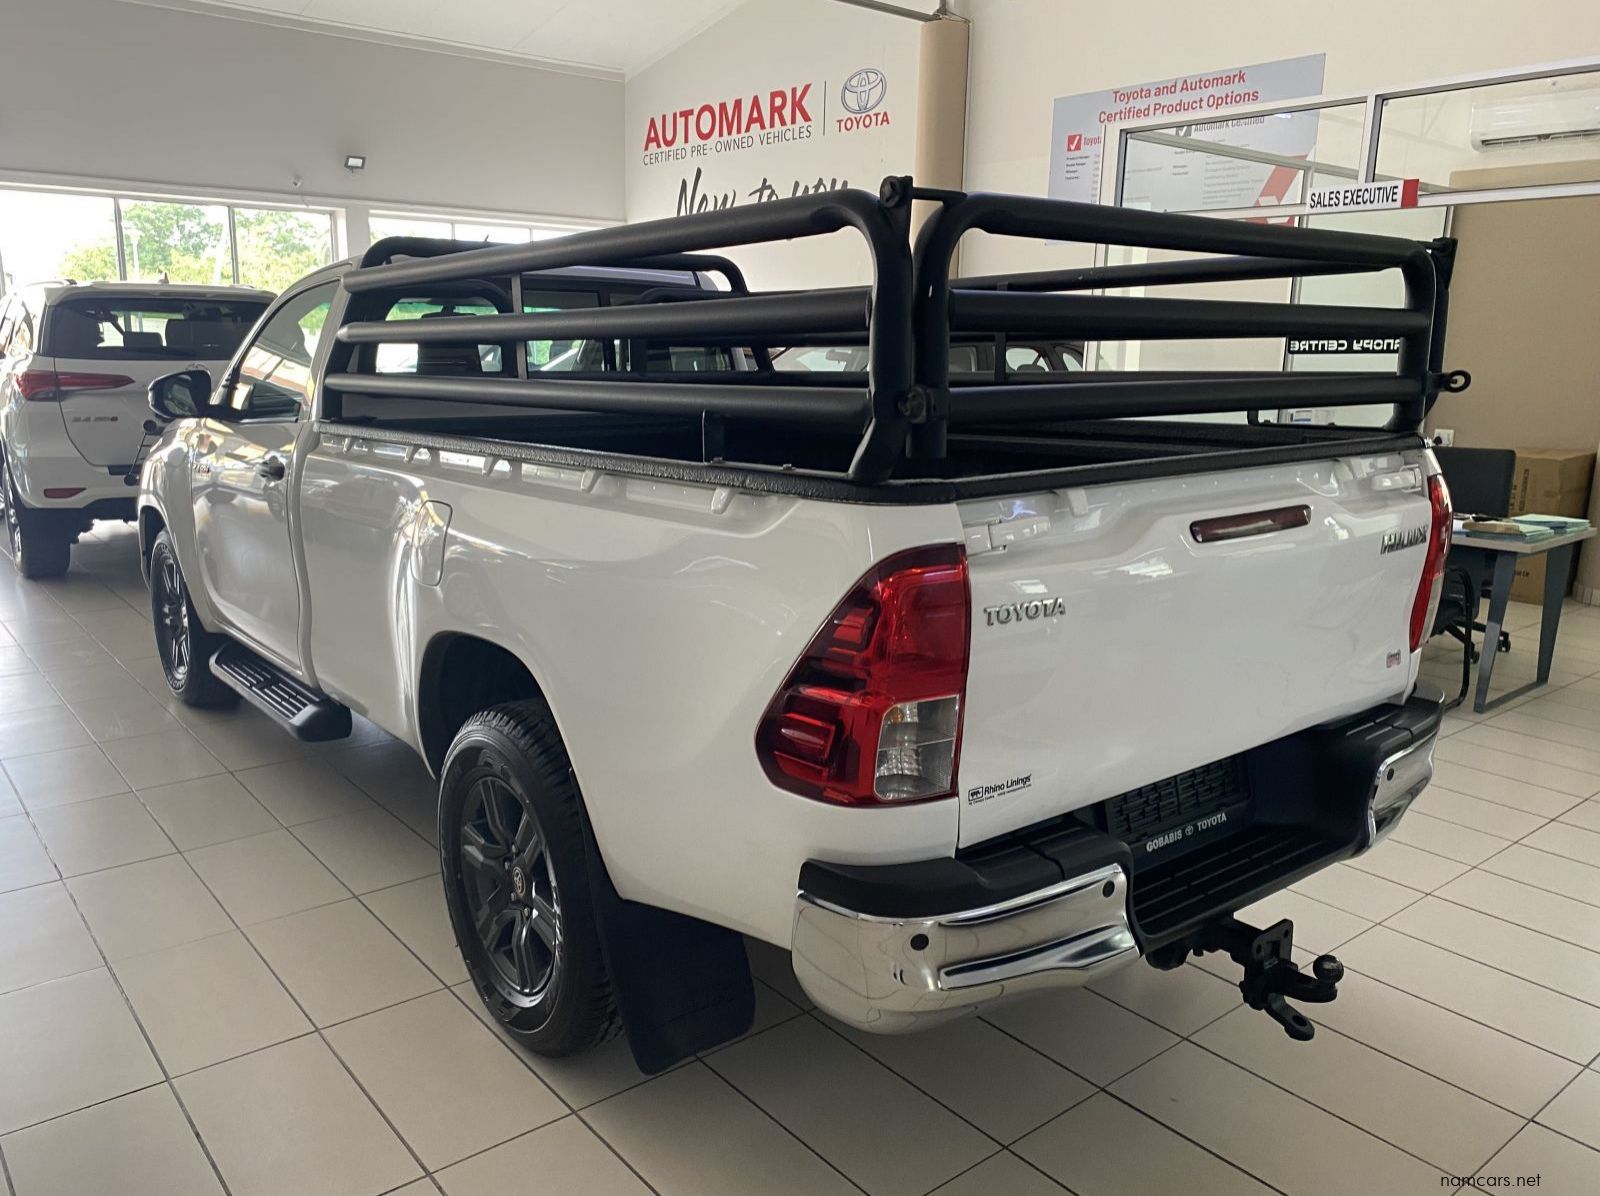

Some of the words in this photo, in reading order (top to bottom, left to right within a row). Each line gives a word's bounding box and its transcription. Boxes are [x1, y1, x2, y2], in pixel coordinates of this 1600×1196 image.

[1112, 87, 1150, 104] Toyota
[1154, 80, 1176, 96] and
[1179, 70, 1245, 92] Automark
[644, 83, 812, 151] AUTOMARK
[836, 111, 890, 132] TOYOTA
[1098, 105, 1149, 123] Certified
[1152, 99, 1202, 115] Product
[1206, 90, 1259, 109] Options
[643, 147, 686, 165] CERTIFIED
[758, 125, 812, 145] VEHICLES
[1309, 190, 1340, 208] SALES
[1342, 185, 1398, 206] EXECUTIVE
[1380, 526, 1426, 554] HILUX
[983, 597, 1065, 626] TOYOTA
[984, 783, 1004, 795] Rhino
[1006, 774, 1031, 788] Linings
[1146, 829, 1182, 851] GOBABIS
[1197, 812, 1227, 831] TOYOTA
